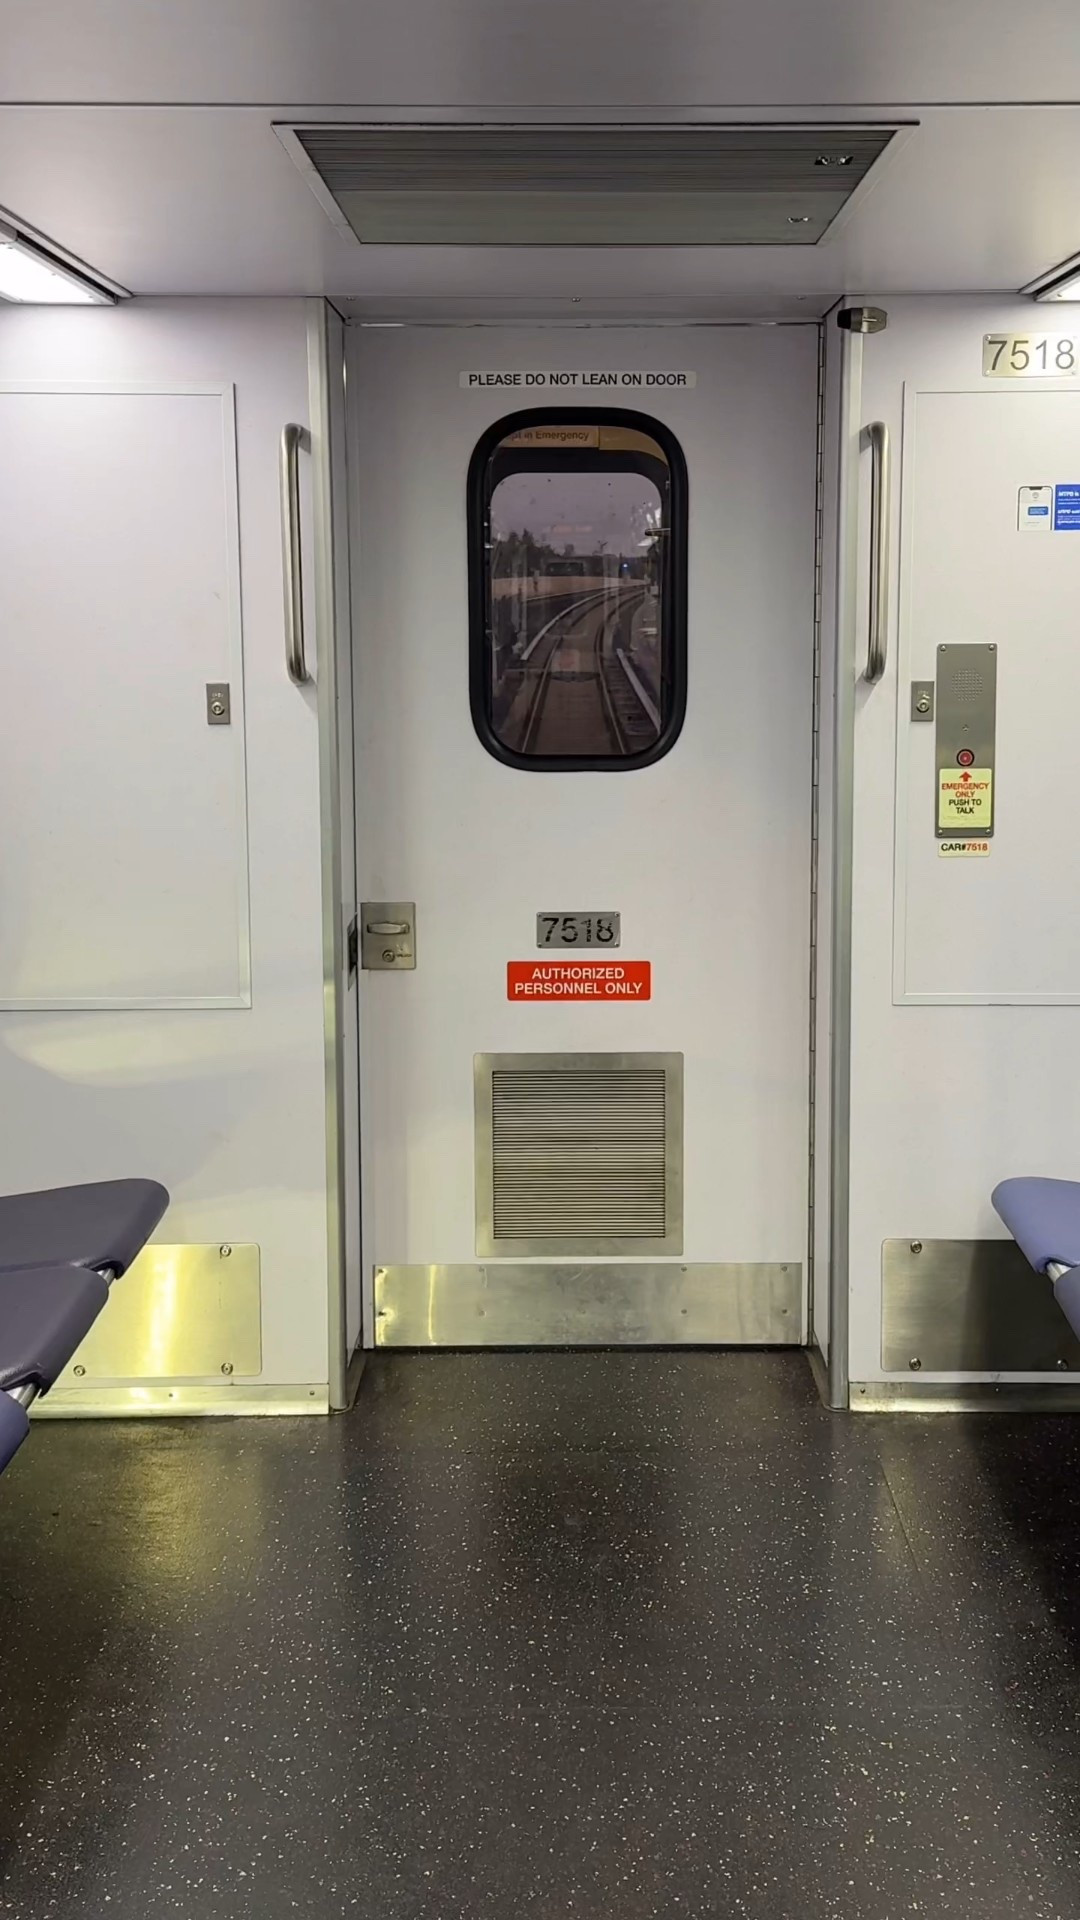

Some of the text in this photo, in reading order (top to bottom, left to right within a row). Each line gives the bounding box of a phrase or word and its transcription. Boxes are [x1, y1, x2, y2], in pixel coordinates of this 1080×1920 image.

[987, 338, 1075, 371] 7518
[468, 373, 687, 386] PLEASE DO NOT LEAN ON DOOR
[535, 431, 590, 442] Emergency
[941, 782, 990, 790] EMERGENCY
[955, 790, 975, 798] ONLY
[948, 798, 982, 806] PUSH TO
[956, 806, 975, 814] TALK
[940, 842, 988, 852] CAR#7518
[542, 917, 614, 943] 7518
[531, 967, 625, 980] AUTHORIZED
[514, 982, 643, 995] PERSONNEL ONLY
